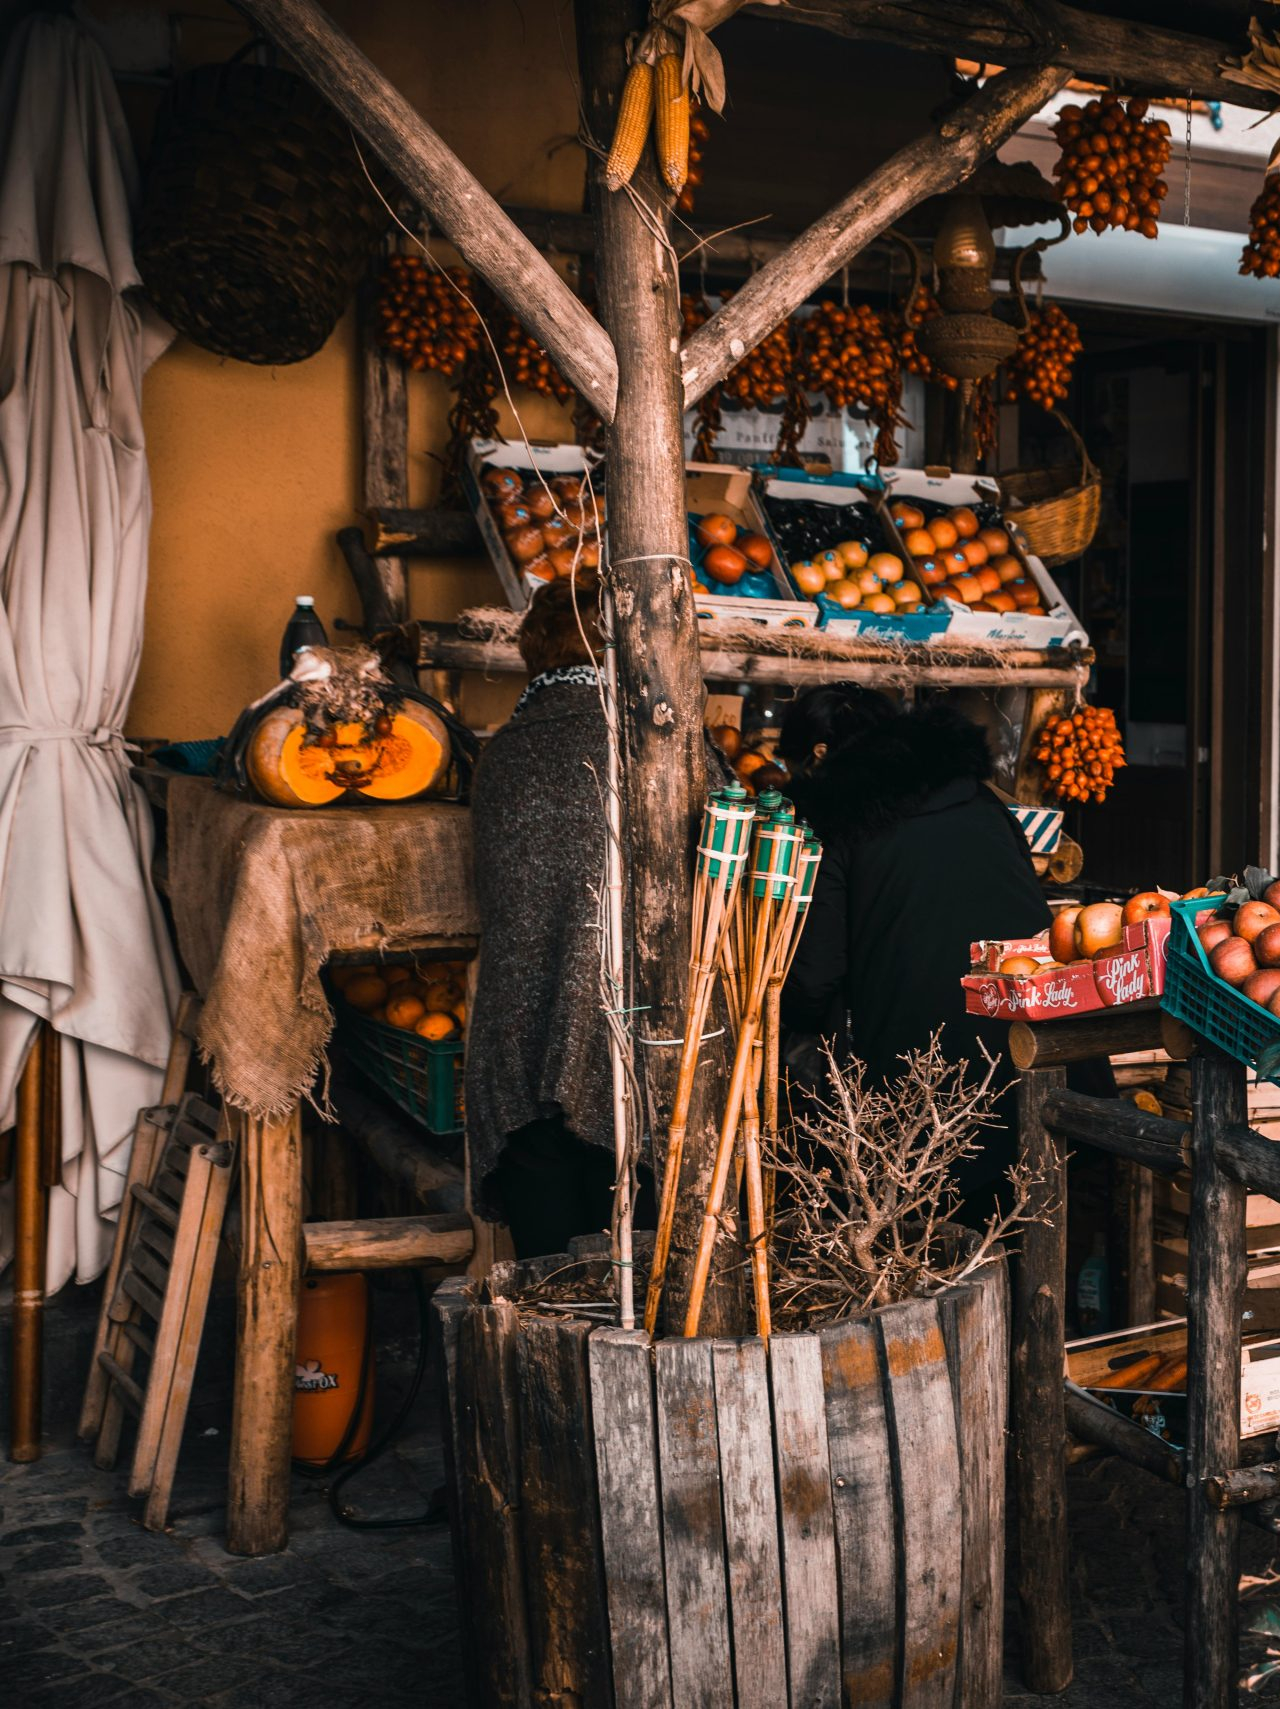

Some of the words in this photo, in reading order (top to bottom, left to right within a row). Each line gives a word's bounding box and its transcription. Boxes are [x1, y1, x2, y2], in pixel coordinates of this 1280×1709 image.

[1098, 953, 1141, 989] Pink
[1112, 970, 1146, 1005] Lady
[1000, 986, 1041, 1012] Pink
[1042, 981, 1078, 1008] Lady
